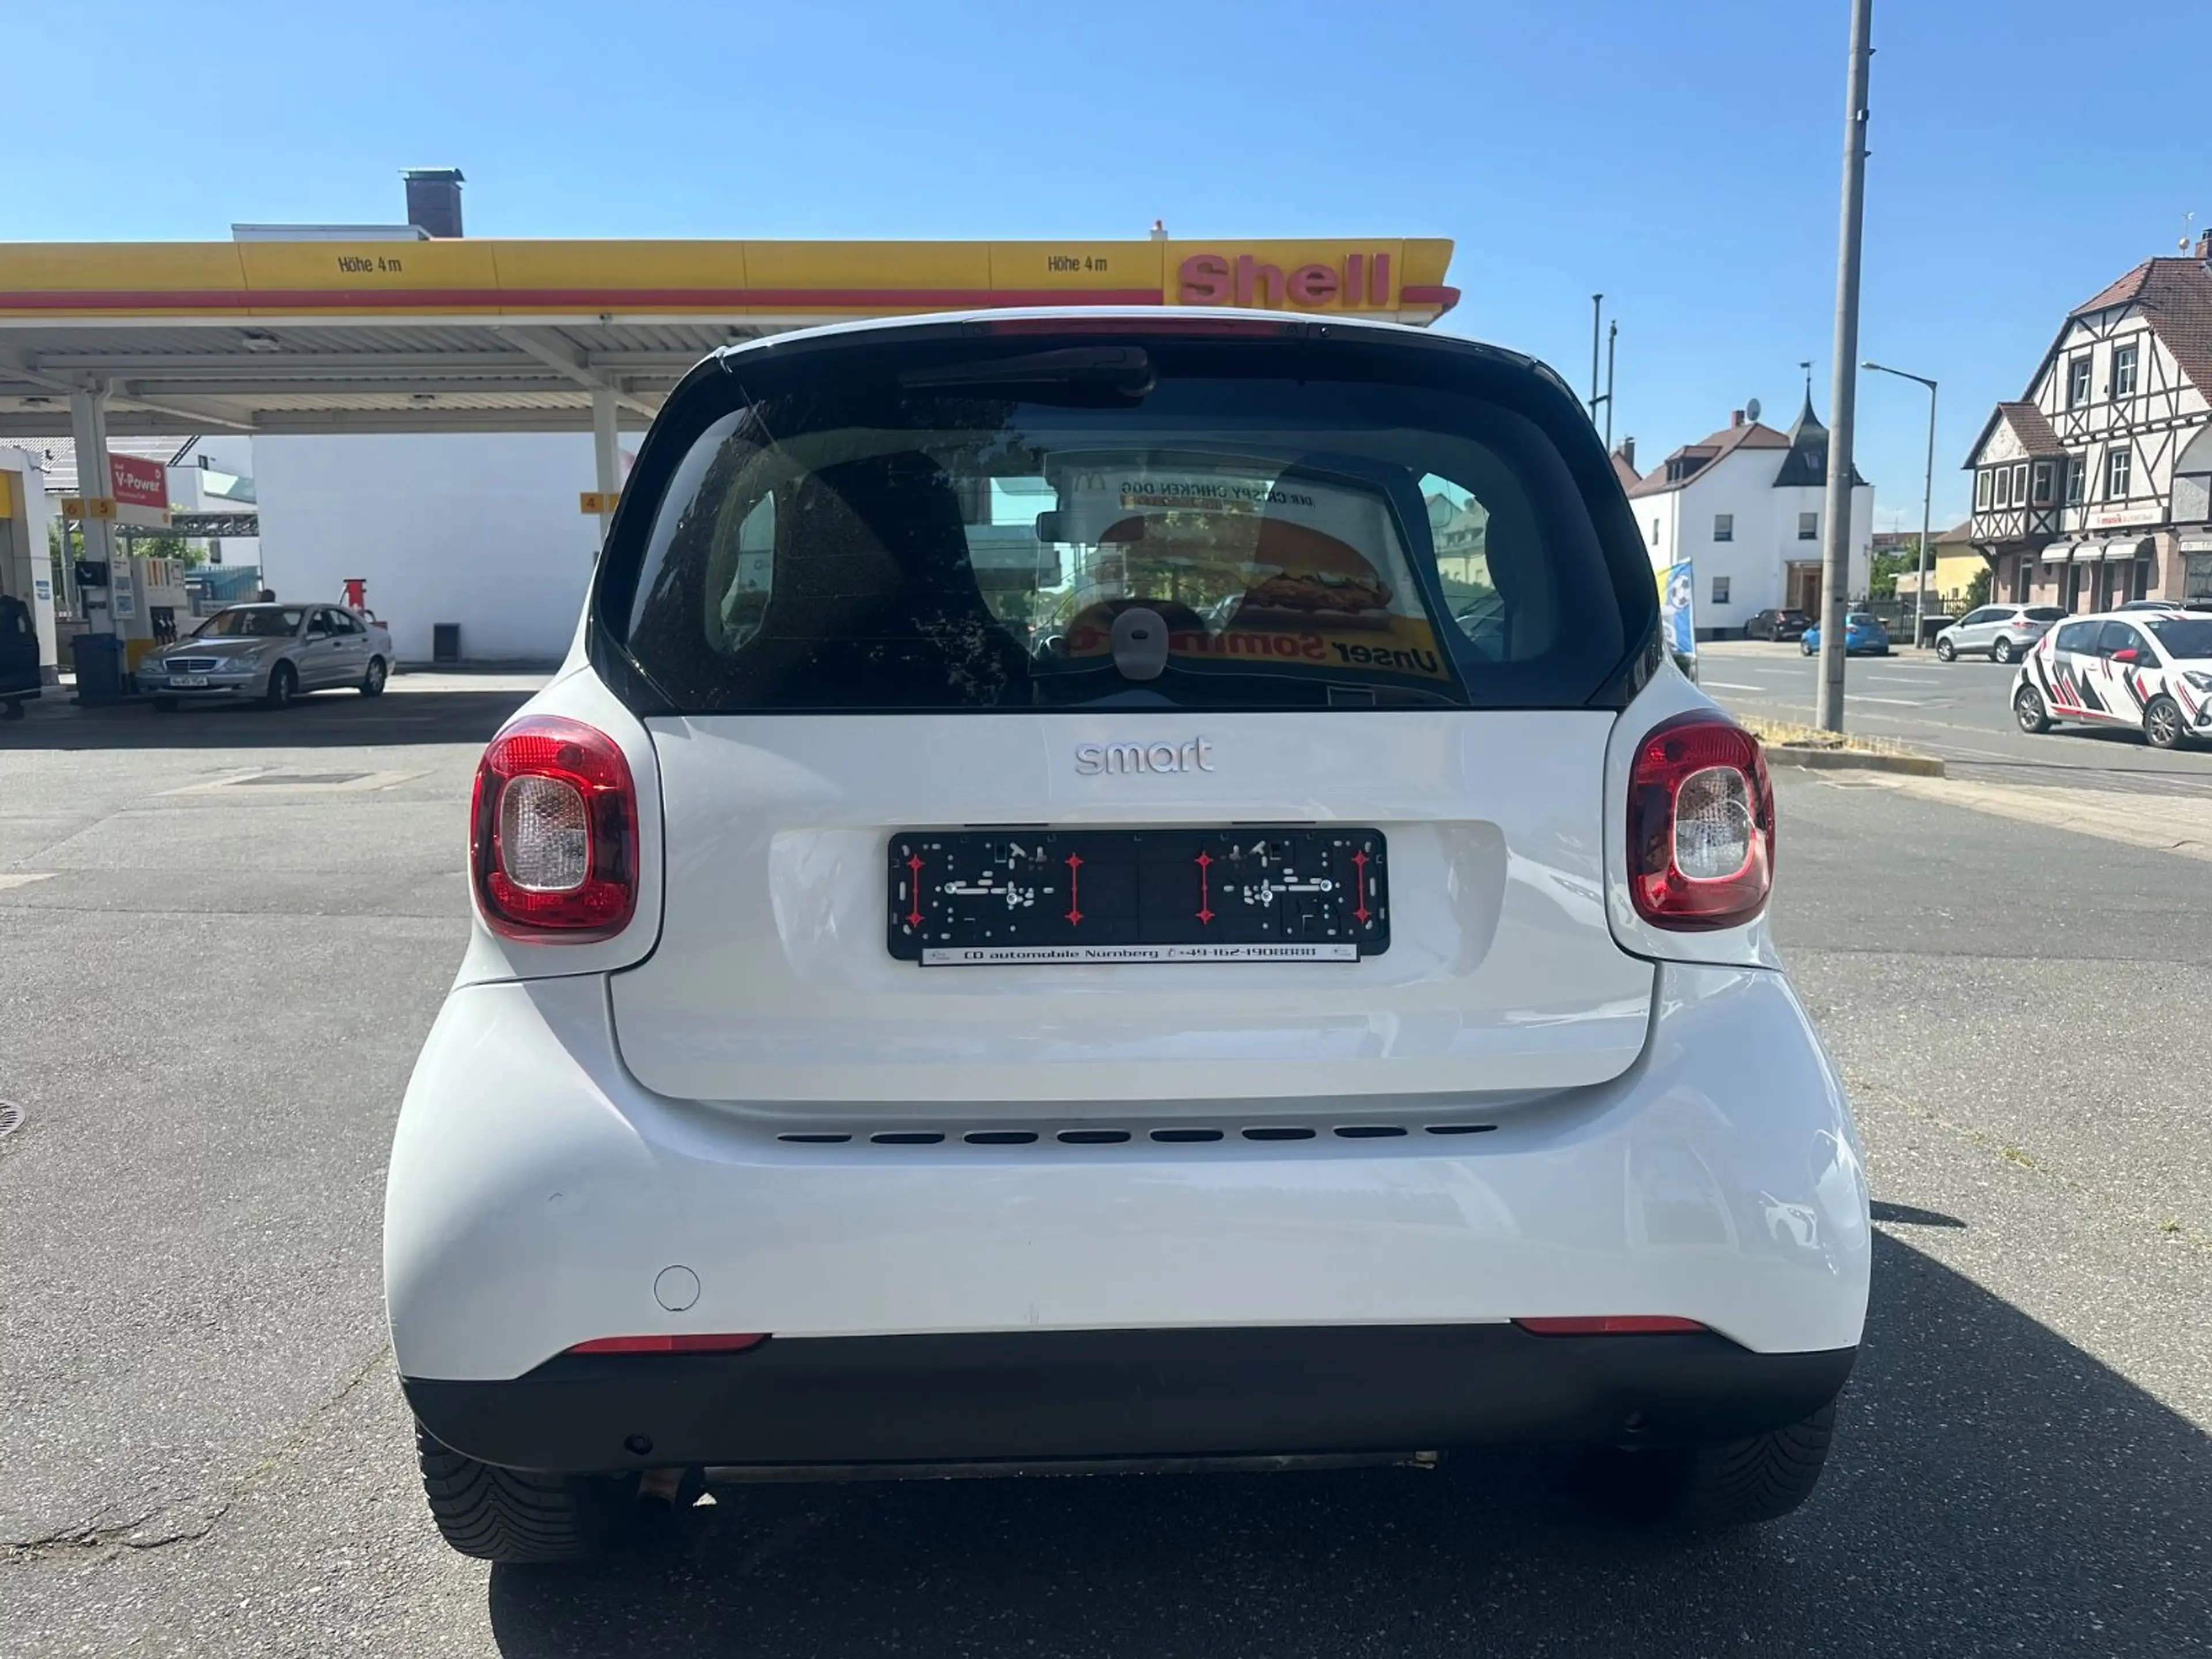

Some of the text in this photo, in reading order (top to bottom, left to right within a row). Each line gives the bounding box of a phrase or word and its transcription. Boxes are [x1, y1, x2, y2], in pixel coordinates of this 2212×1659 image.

[338, 256, 373, 273] Höhe
[1048, 255, 1081, 272] Höhe
[1178, 253, 1391, 309] Shell
[115, 471, 161, 493] V-Power
[100, 502, 108, 513] 5
[585, 497, 596, 509] 4
[1075, 735, 1217, 776] smart
[964, 950, 984, 960] CD
[989, 950, 1081, 960] automobile
